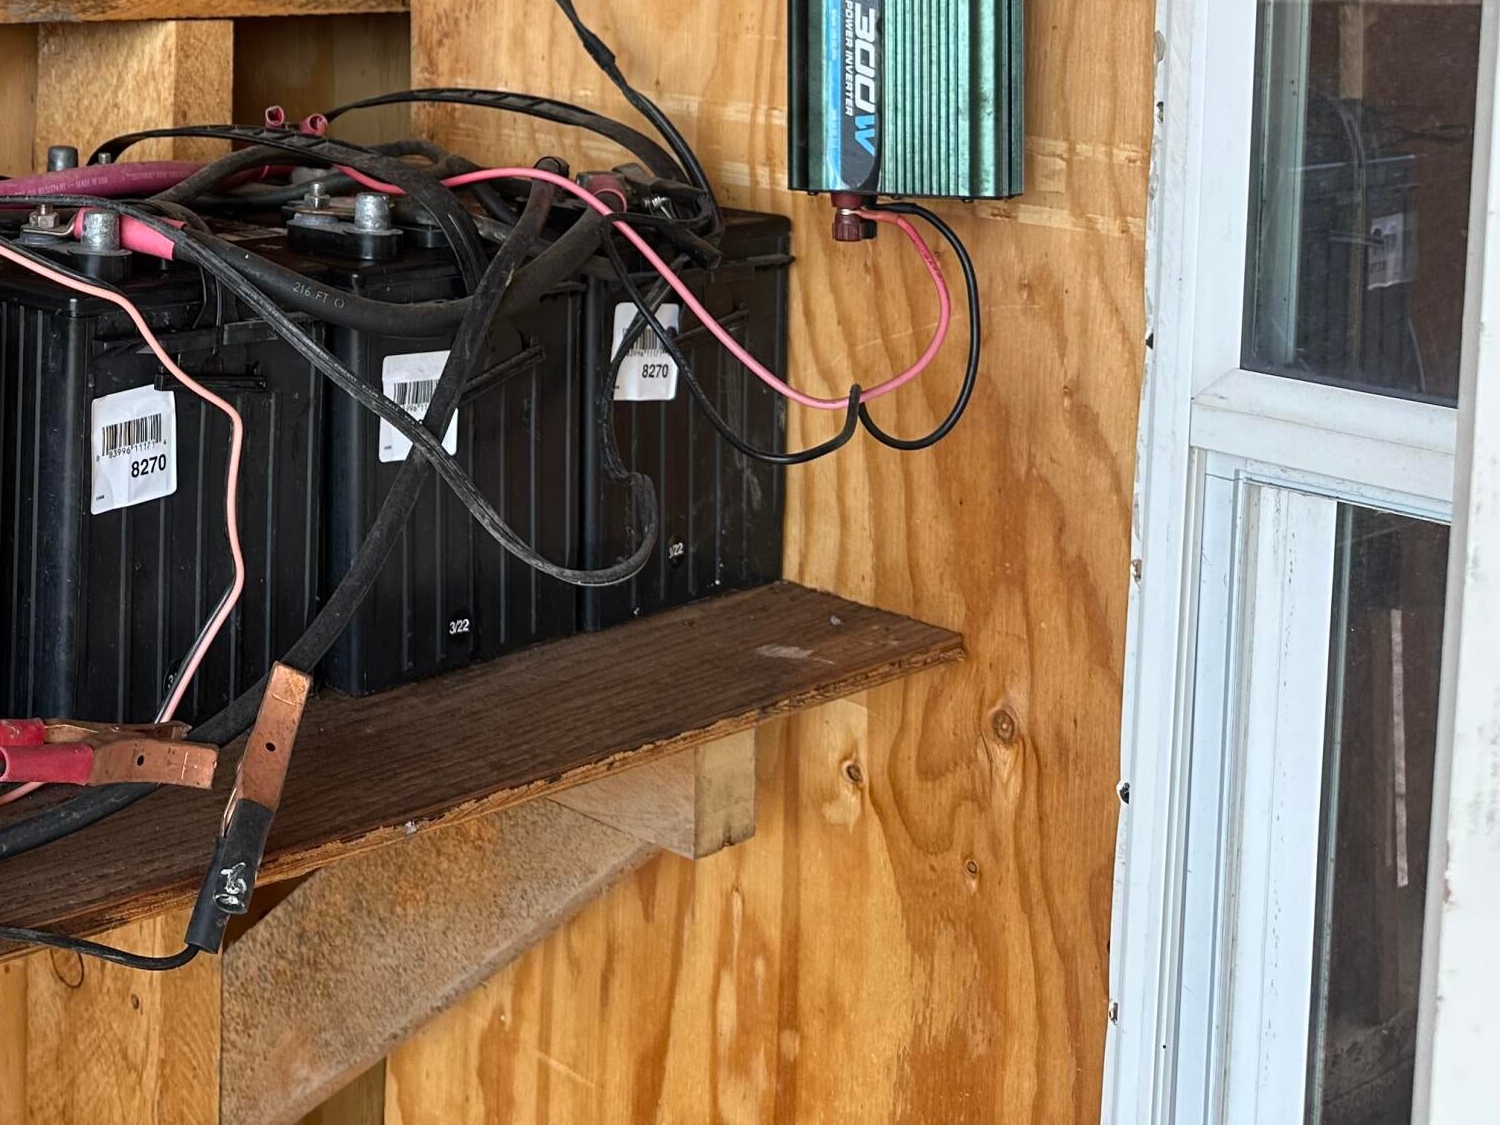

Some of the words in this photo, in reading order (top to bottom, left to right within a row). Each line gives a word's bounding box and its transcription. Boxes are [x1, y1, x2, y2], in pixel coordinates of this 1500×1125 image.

[845, 0, 854, 50] POWER
[845, 51, 854, 117] INVERTER
[854, 2, 877, 157] 300W
[293, 282, 312, 297] 216
[315, 291, 329, 304] FT
[641, 364, 669, 379] 8270
[131, 454, 167, 478] 8270
[449, 618, 470, 635] 3/22
